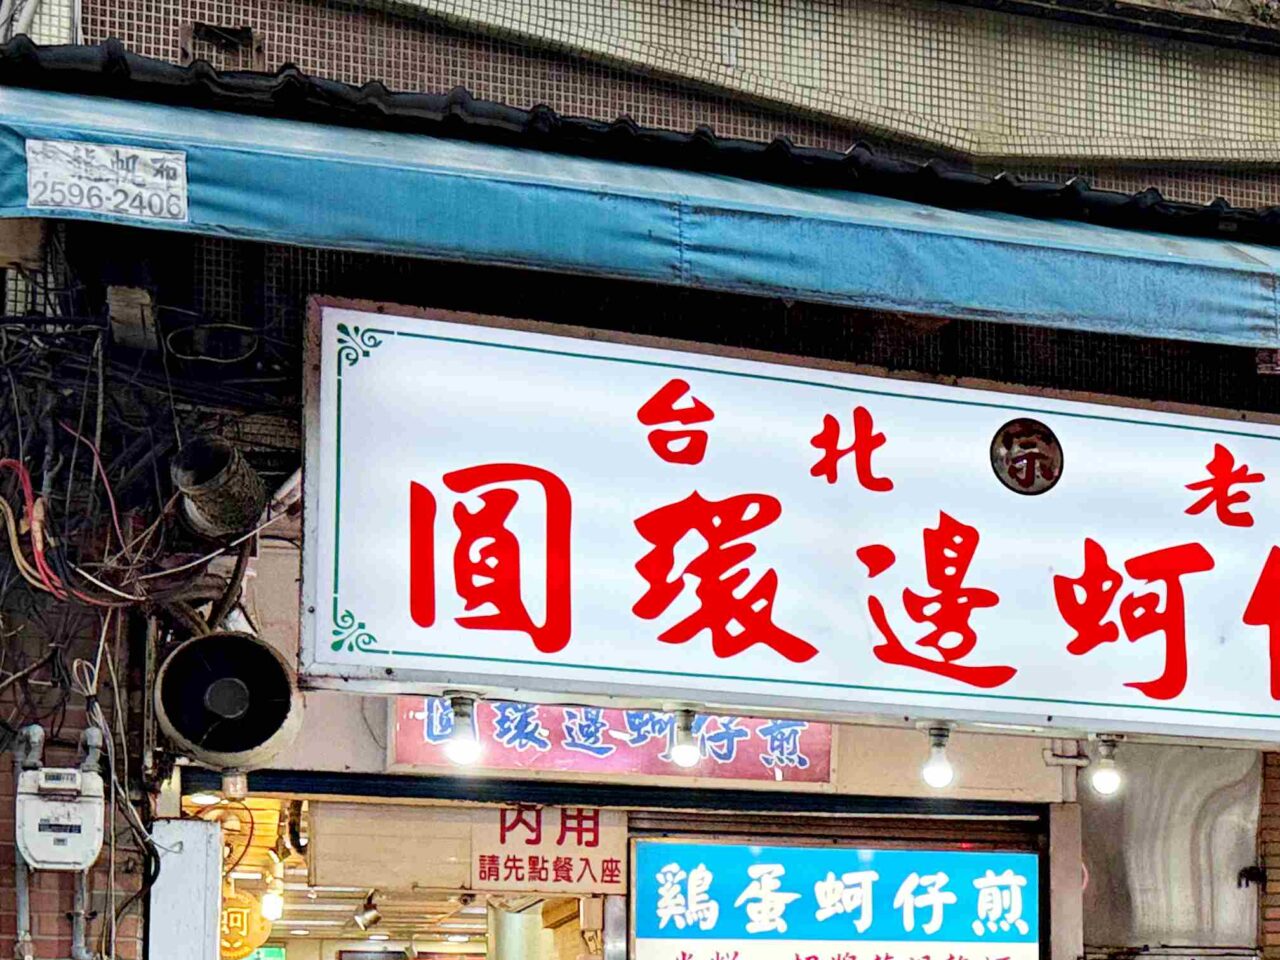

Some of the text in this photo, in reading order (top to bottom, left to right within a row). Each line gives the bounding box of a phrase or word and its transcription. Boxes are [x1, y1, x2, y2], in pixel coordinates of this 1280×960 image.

[32, 180, 182, 216] 2596-2406
[637, 379, 893, 491] 台北
[479, 855, 621, 884] 請先點餐入座
